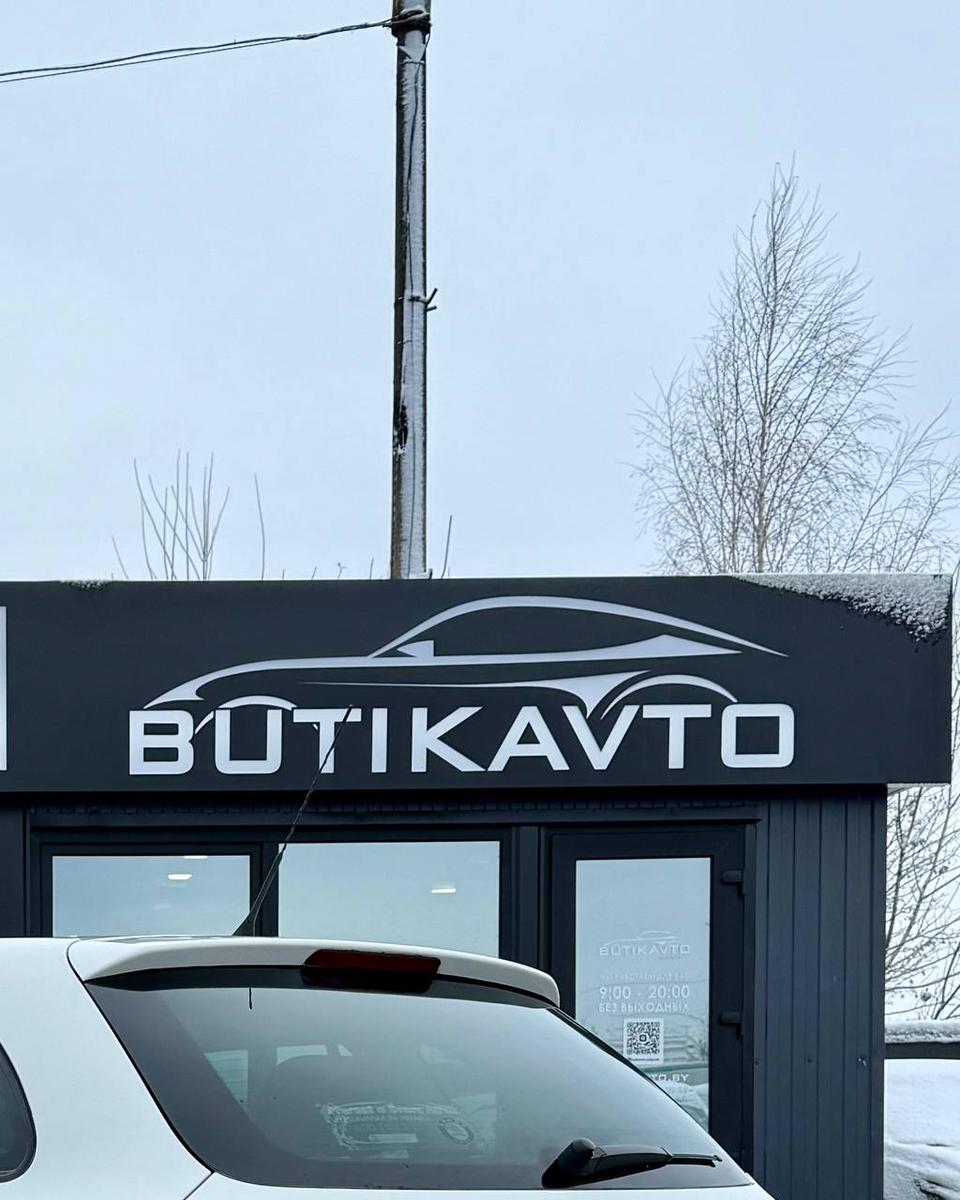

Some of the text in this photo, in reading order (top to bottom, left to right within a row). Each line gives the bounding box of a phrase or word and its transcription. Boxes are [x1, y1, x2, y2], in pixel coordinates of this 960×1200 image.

[128, 702, 795, 776] BUTIKAVTO
[599, 985, 631, 1000] 9:00
[648, 984, 690, 999] 20:00
